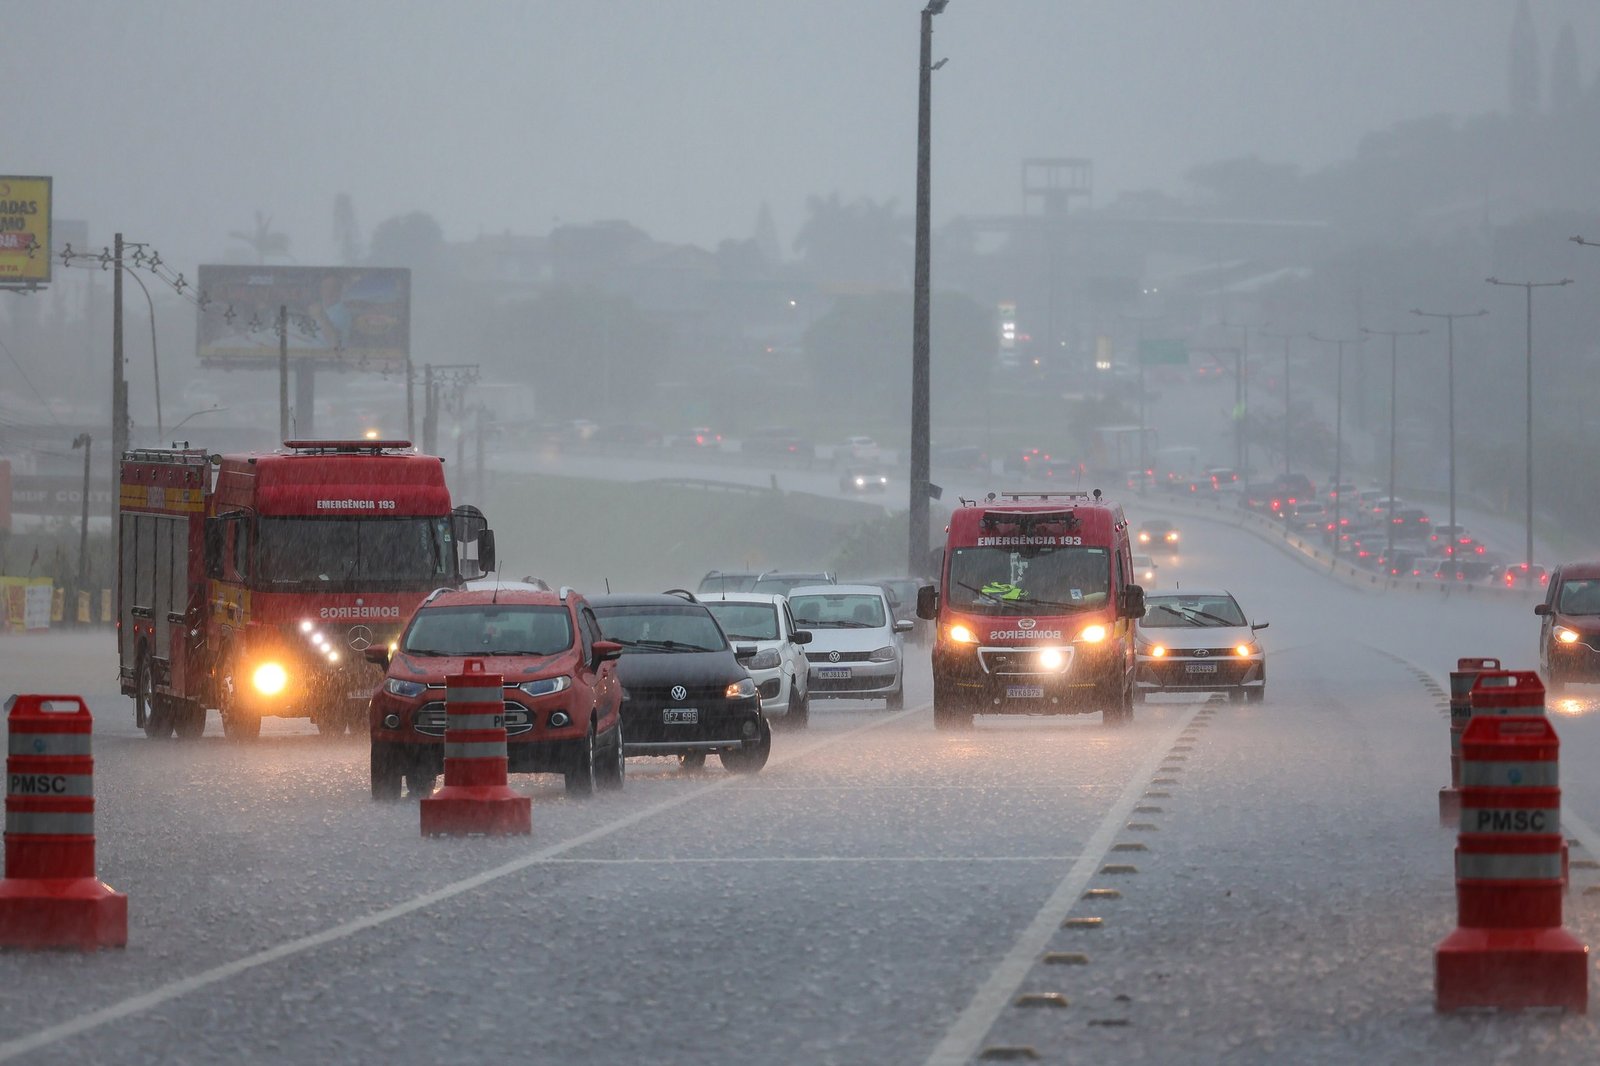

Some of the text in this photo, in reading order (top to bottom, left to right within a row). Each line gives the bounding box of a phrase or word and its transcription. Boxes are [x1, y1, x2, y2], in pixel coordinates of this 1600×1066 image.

[317, 499, 396, 510] EMERGÊNCIA 193
[977, 534, 1082, 547] EMERGÊNCIA 193
[11, 776, 66, 793] PMSC
[1477, 810, 1545, 831] PMSC
